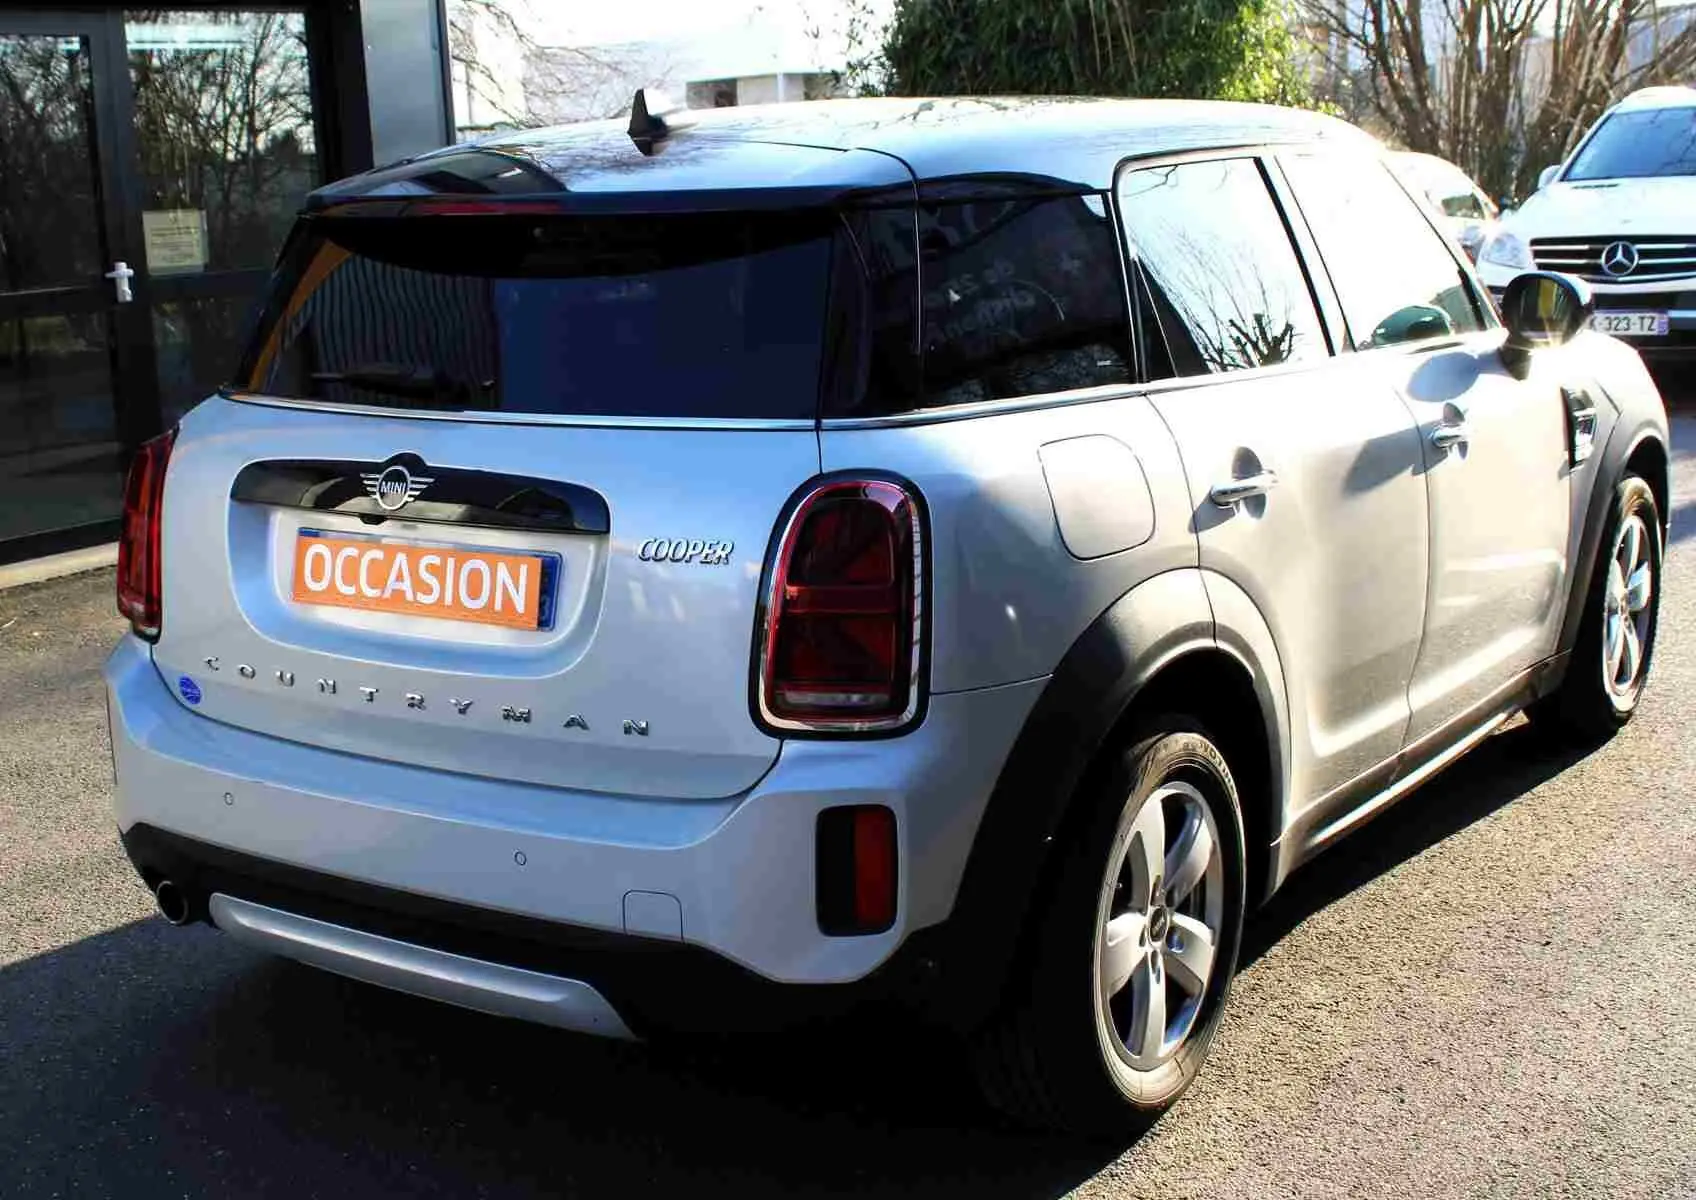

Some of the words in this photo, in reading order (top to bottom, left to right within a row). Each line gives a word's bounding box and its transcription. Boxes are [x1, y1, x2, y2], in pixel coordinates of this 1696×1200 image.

[381, 480, 406, 495] MINI
[637, 537, 735, 565] COOPER
[304, 543, 528, 613] OCCASION
[204, 656, 649, 736] COUNTRYMAN
